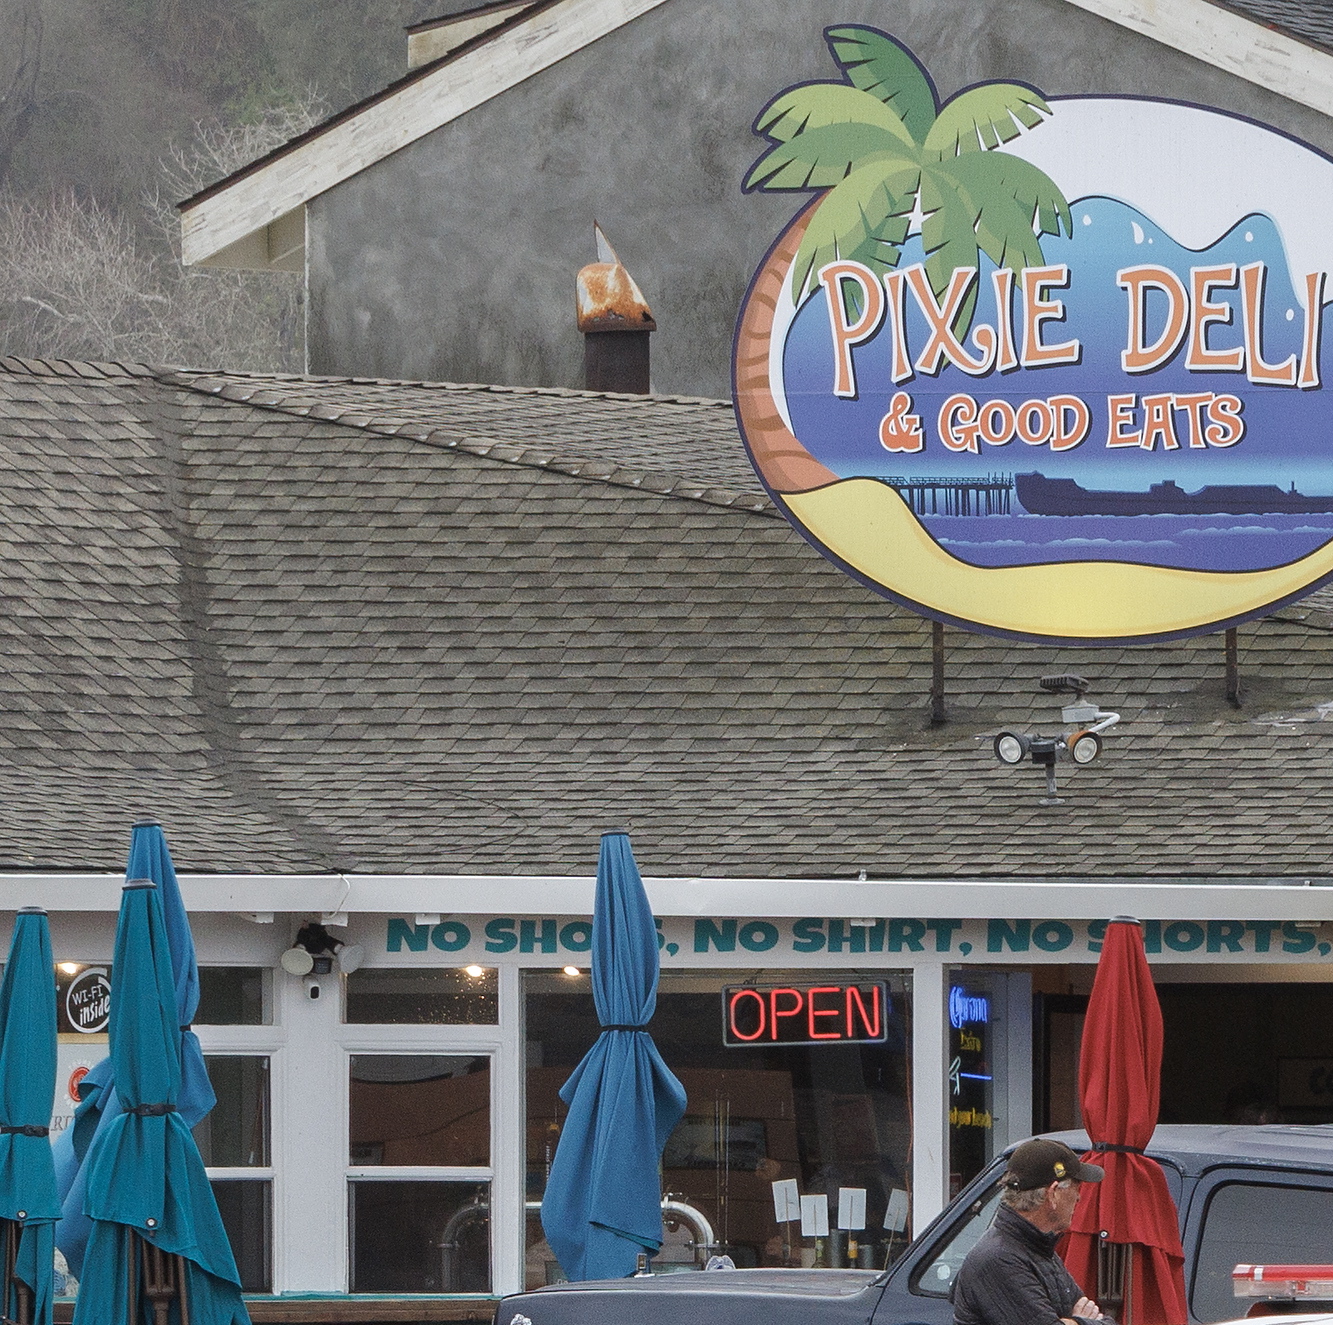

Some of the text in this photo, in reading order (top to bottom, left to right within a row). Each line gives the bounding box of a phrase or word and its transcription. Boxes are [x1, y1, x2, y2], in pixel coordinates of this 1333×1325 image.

[820, 261, 1326, 399] PIXIE DELI
[879, 392, 1245, 453] & GOOD EATS
[386, 918, 471, 953] NO
[693, 919, 779, 953] NO
[987, 919, 1074, 953] NO
[72, 984, 103, 1006] WI-FI
[79, 995, 111, 1027] inside
[730, 986, 880, 1040] OPEN
[949, 986, 988, 1028] Corona
